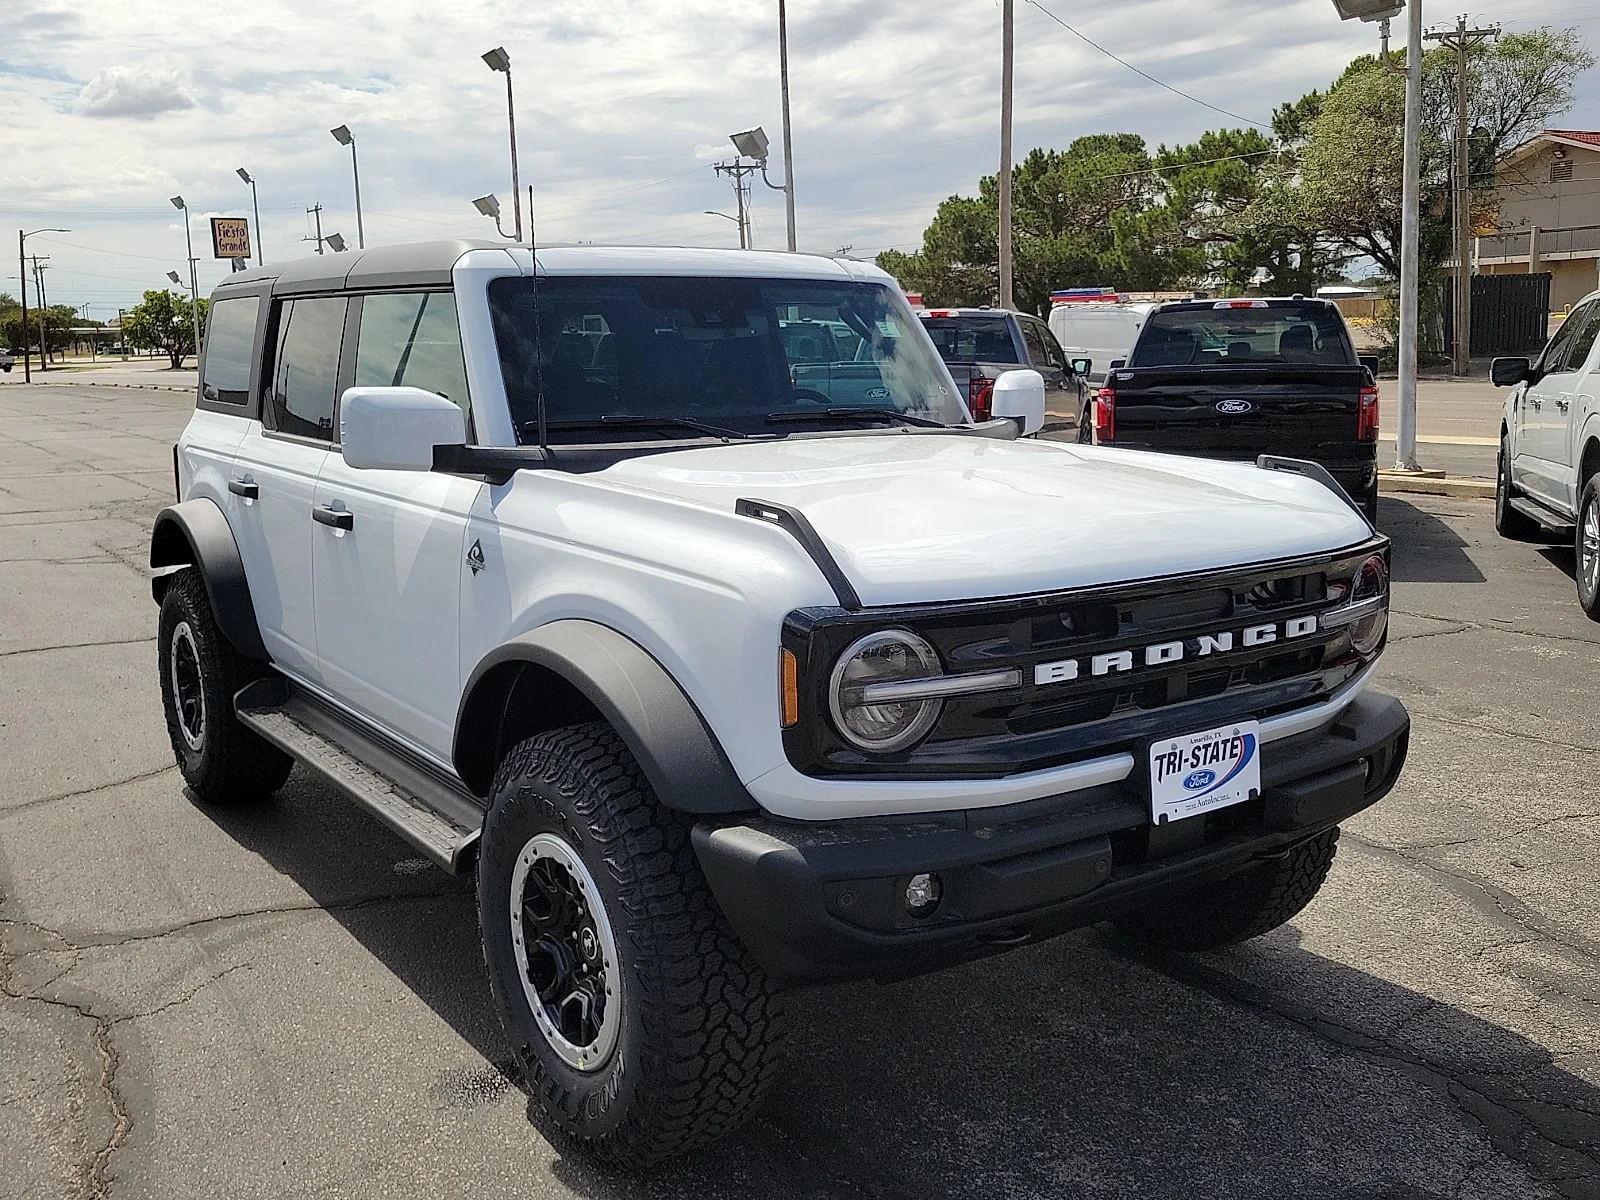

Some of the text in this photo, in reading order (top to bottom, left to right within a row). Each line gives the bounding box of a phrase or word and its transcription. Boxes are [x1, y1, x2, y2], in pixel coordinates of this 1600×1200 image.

[218, 222, 246, 238] Fiesta
[219, 238, 247, 252] Grande
[1034, 615, 1317, 686] BRONCO
[1154, 735, 1242, 784] TRI-STATE
[1189, 772, 1211, 788] Ford
